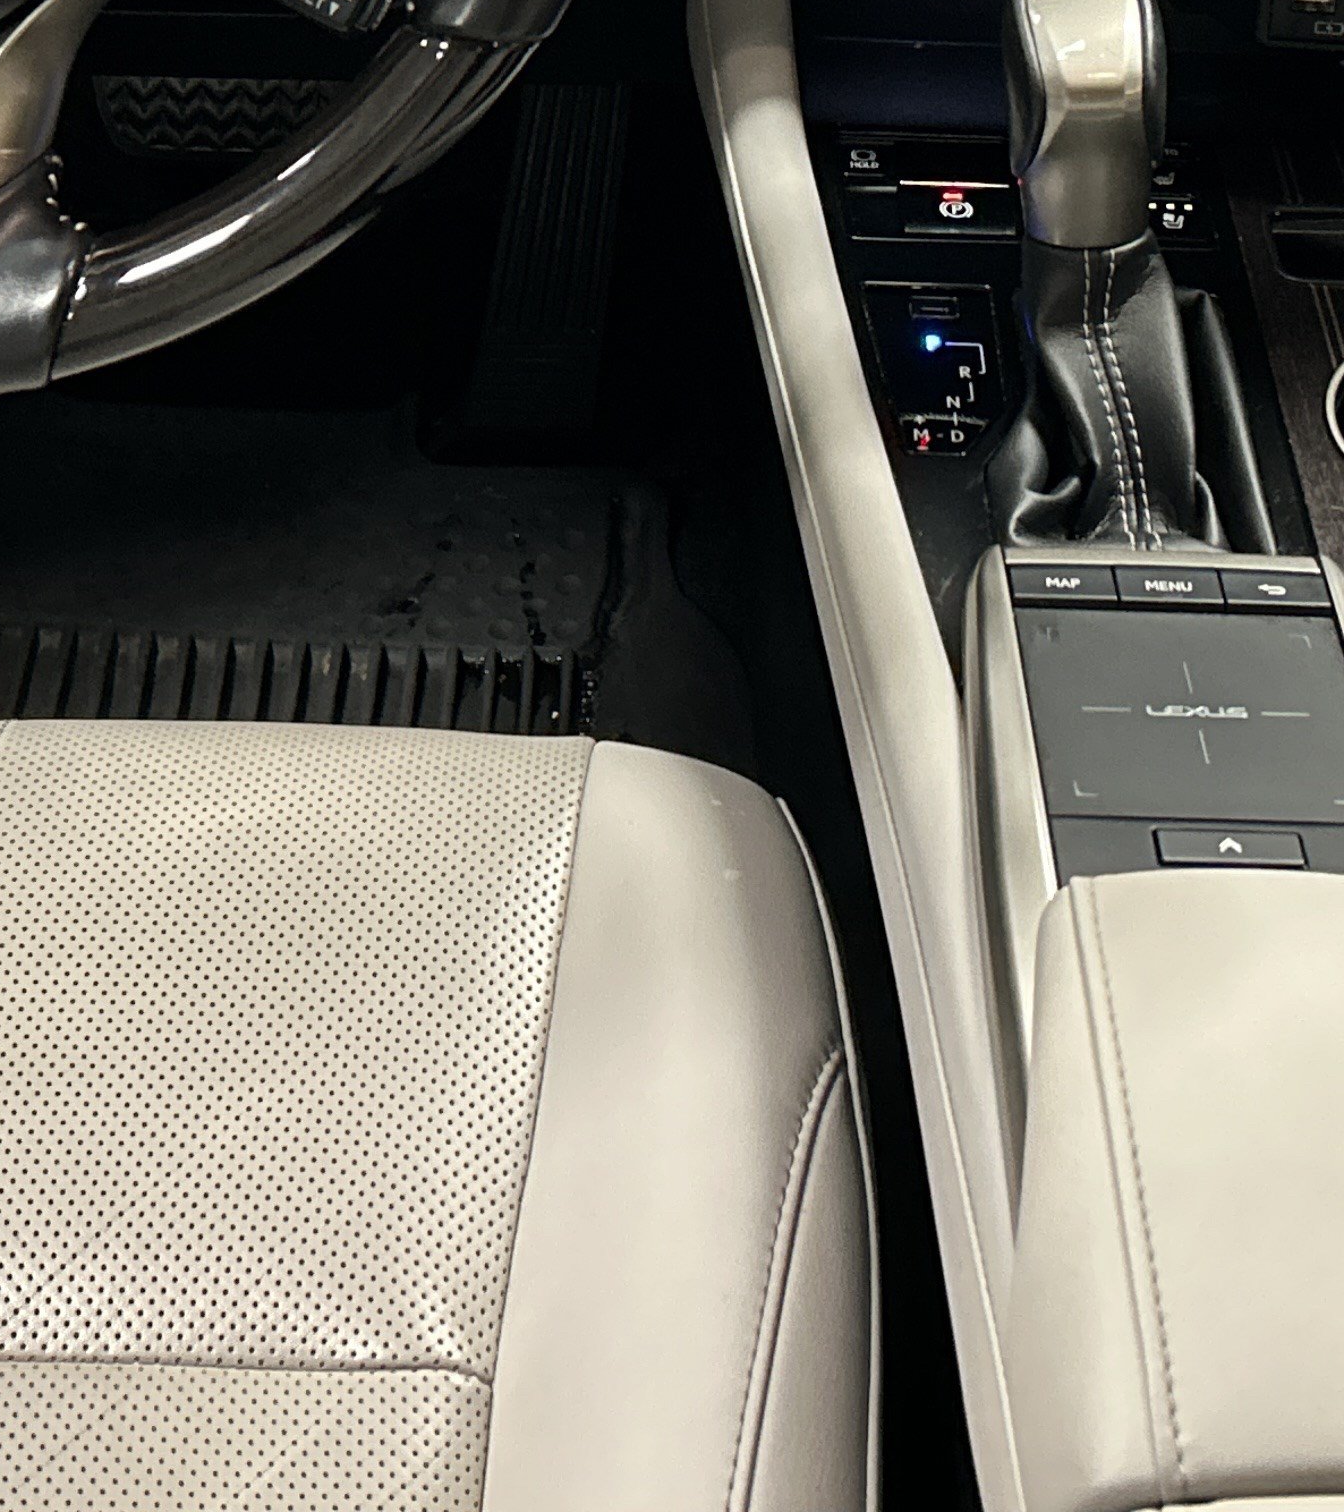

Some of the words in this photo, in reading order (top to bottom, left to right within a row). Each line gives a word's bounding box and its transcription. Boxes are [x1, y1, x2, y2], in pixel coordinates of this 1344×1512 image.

[958, 365, 972, 379] R
[945, 395, 961, 409] N
[912, 427, 930, 442] M
[950, 429, 965, 444] D
[1044, 575, 1082, 591] MAP
[1143, 579, 1194, 595] MENU
[1144, 703, 1250, 720] LEXUS
